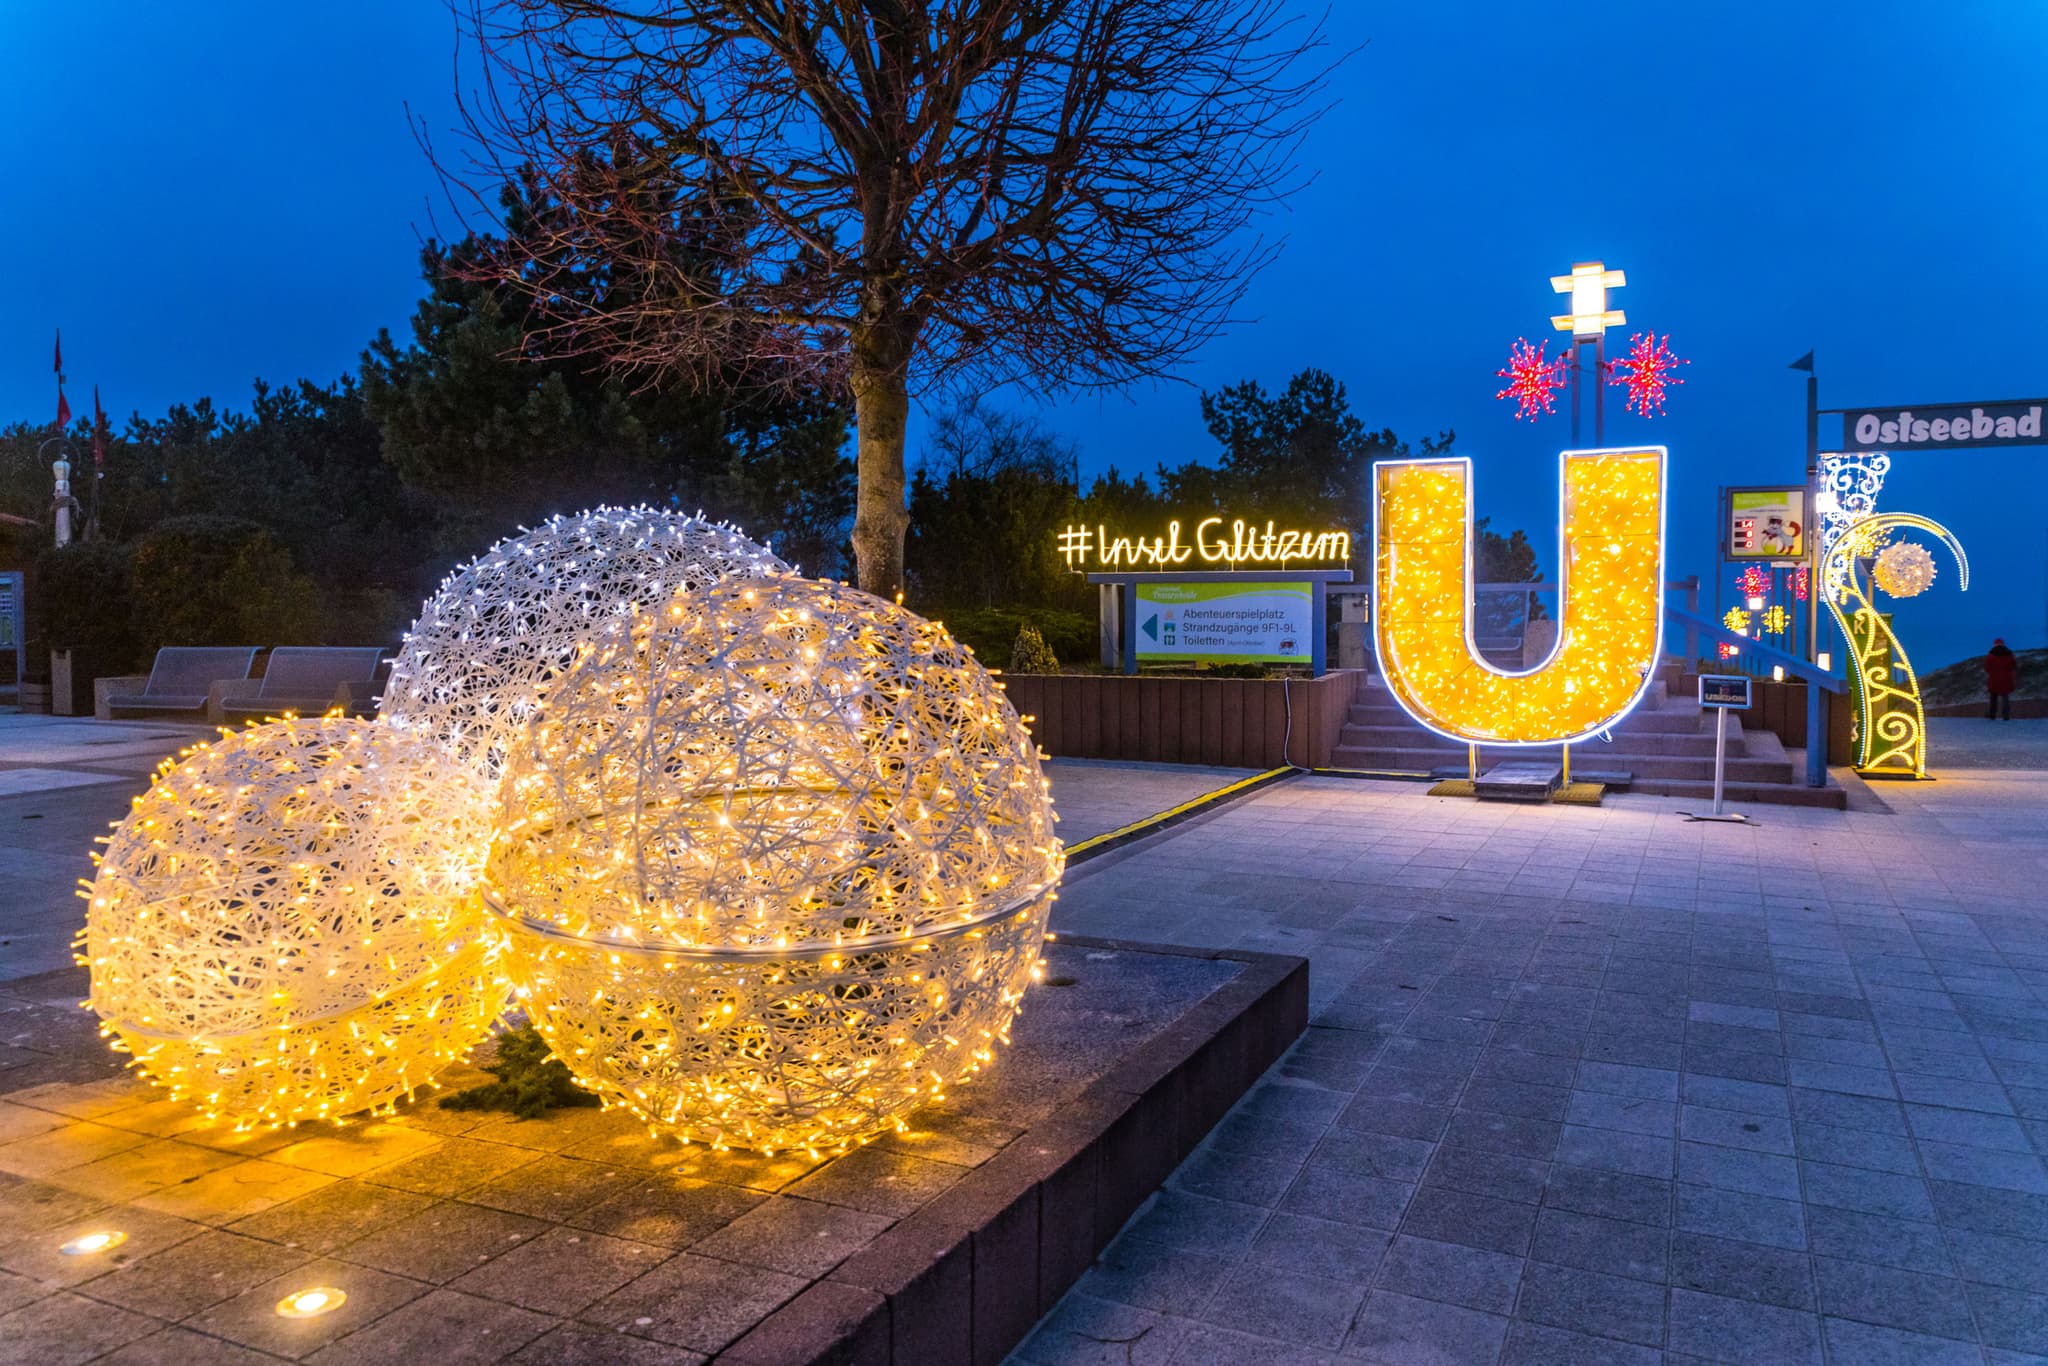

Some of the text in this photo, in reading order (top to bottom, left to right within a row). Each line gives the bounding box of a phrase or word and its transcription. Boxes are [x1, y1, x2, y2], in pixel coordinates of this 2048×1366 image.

[1855, 406, 2042, 444] Ostseebad
[1197, 517, 1349, 561] Glitzern
[1373, 446, 1668, 747] U
[1183, 609, 1285, 621] Abenteuerspielplatz
[1183, 623, 1297, 634] Strandzugänge 9F1-9L
[1183, 636, 1225, 646] Toiletten
